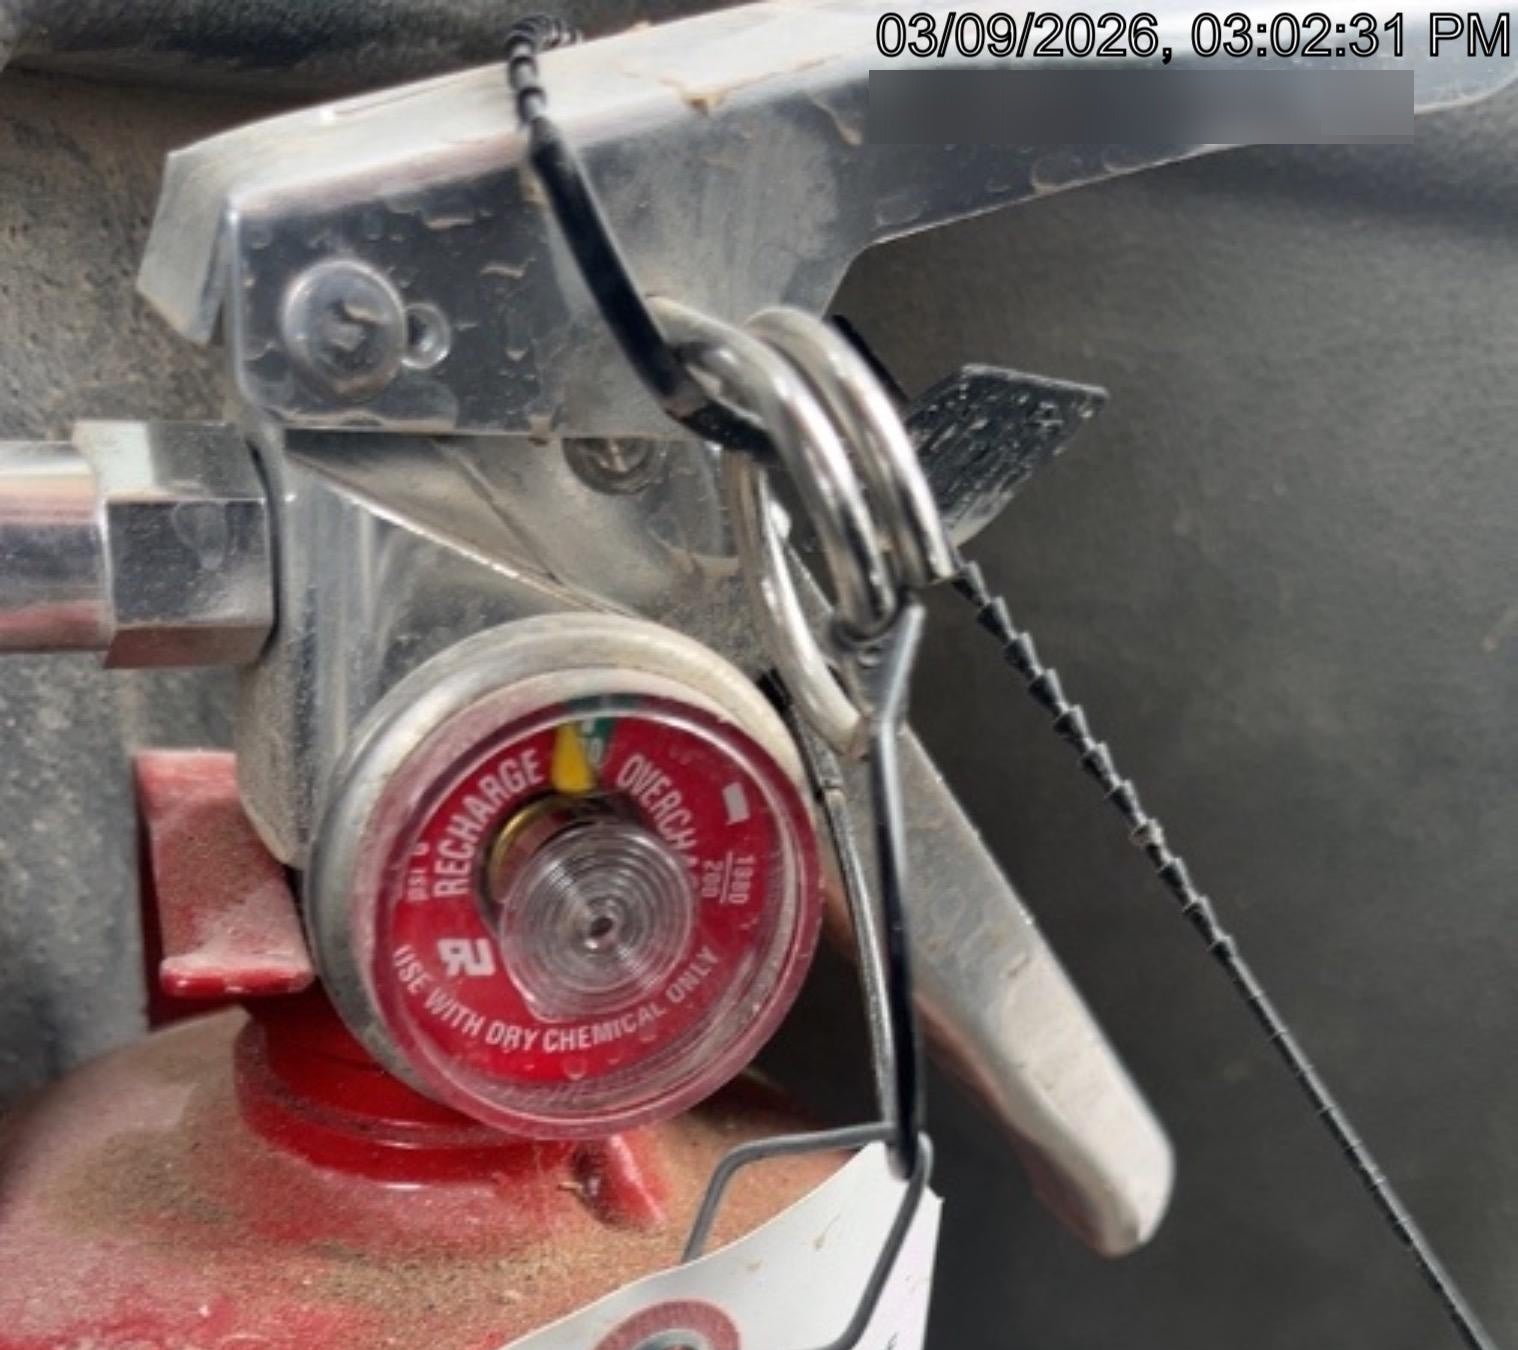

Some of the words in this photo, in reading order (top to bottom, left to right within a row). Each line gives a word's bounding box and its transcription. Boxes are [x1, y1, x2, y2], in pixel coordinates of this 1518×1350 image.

[432, 749, 545, 898] RECHARGE
[392, 943, 427, 995] USE
[424, 984, 487, 1037] WITH
[485, 1021, 538, 1051] DRY
[542, 1001, 667, 1053] CHEMICAL
[666, 945, 720, 1005] ONLY
